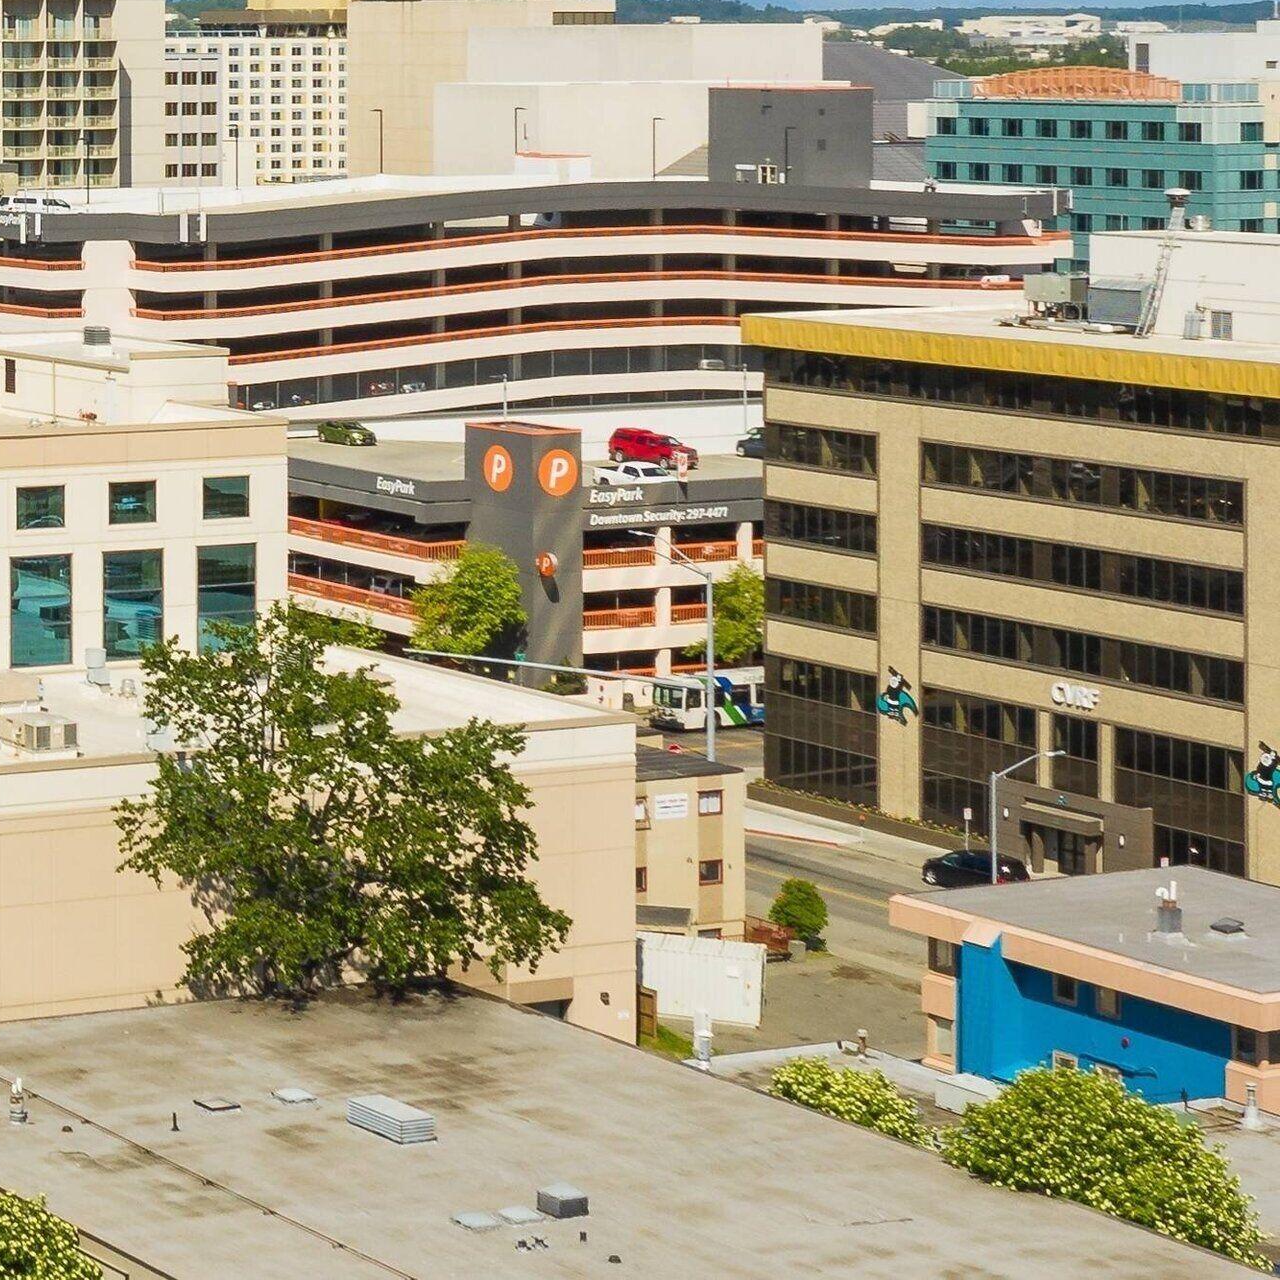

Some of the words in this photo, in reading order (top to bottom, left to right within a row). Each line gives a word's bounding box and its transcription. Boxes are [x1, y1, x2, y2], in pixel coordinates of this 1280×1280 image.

[490, 453, 507, 483] P
[548, 457, 570, 489] P
[376, 476, 416, 497] EasyPark
[589, 486, 644, 506] EasyPark
[590, 512, 643, 526] Downtown
[643, 508, 686, 523] Security:
